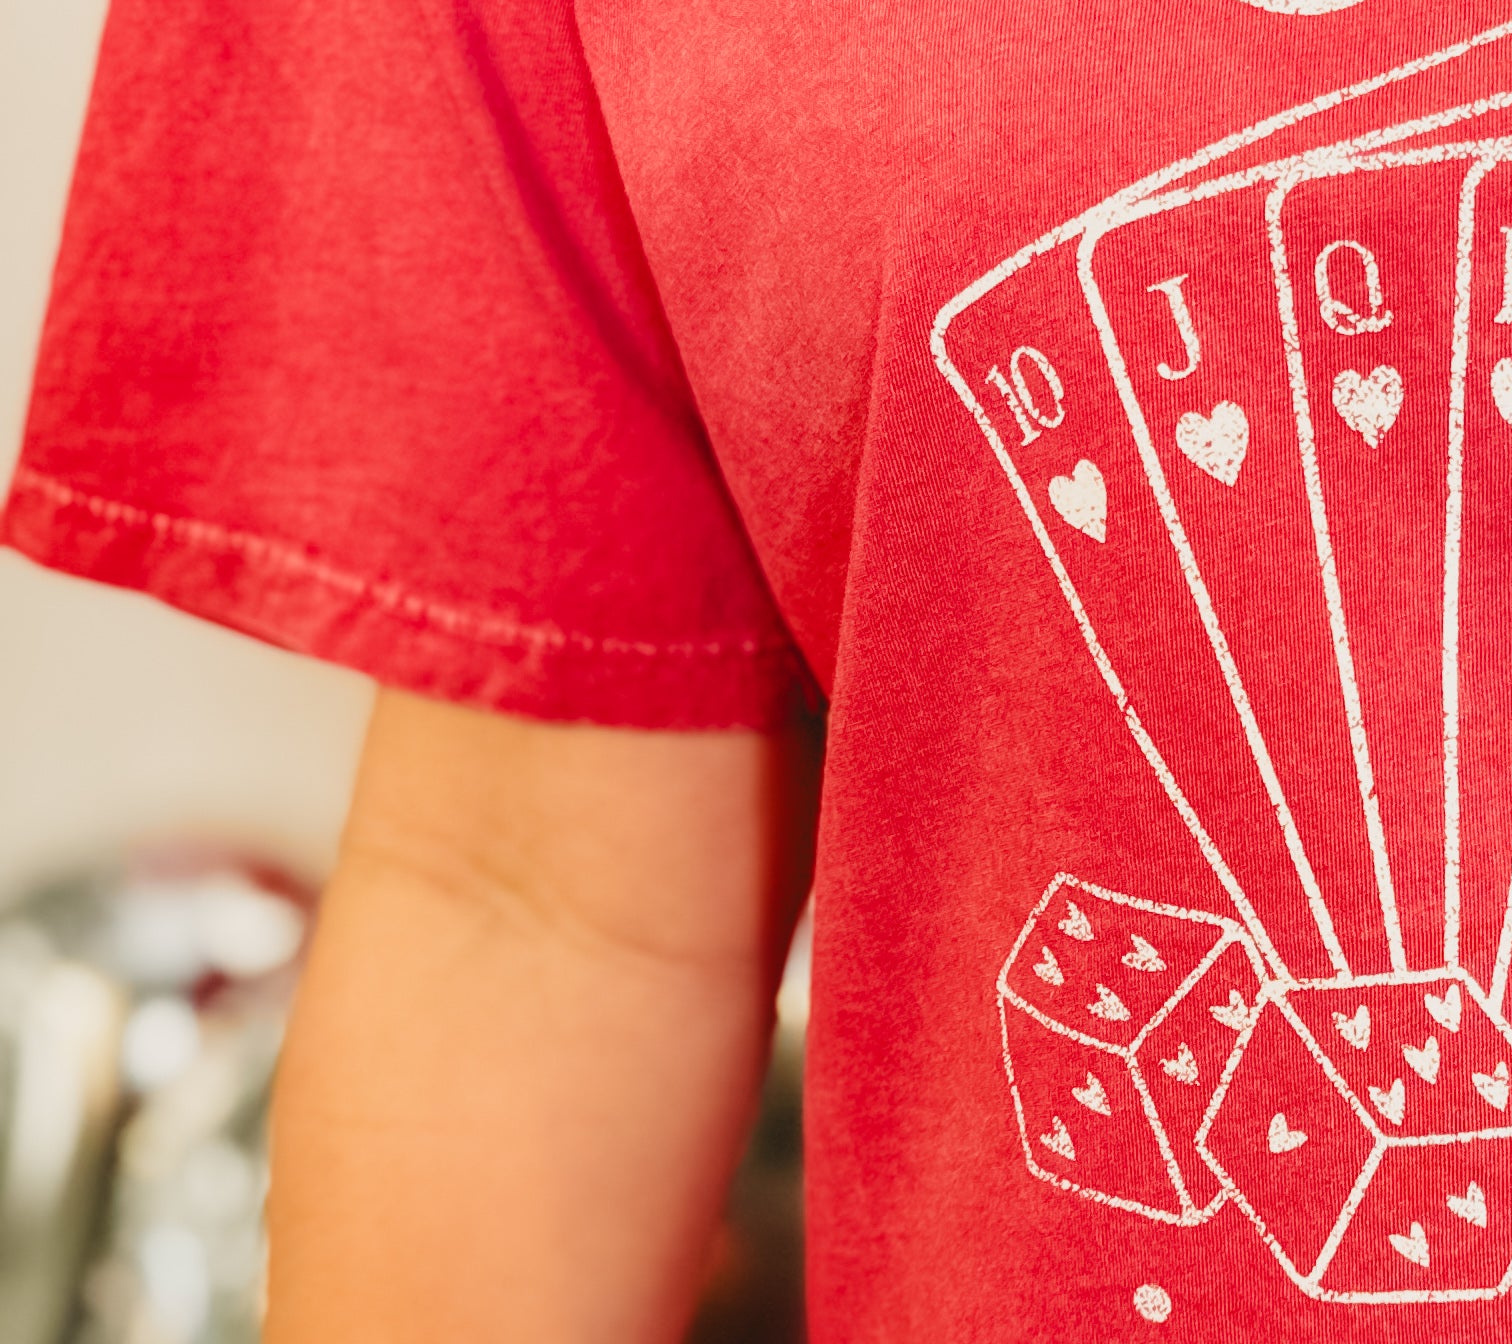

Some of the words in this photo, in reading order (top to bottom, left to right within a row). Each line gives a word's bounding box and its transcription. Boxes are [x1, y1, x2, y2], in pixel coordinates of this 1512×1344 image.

[1146, 273, 1201, 382] J
[1314, 239, 1395, 336] Q
[984, 344, 1066, 447] 10
